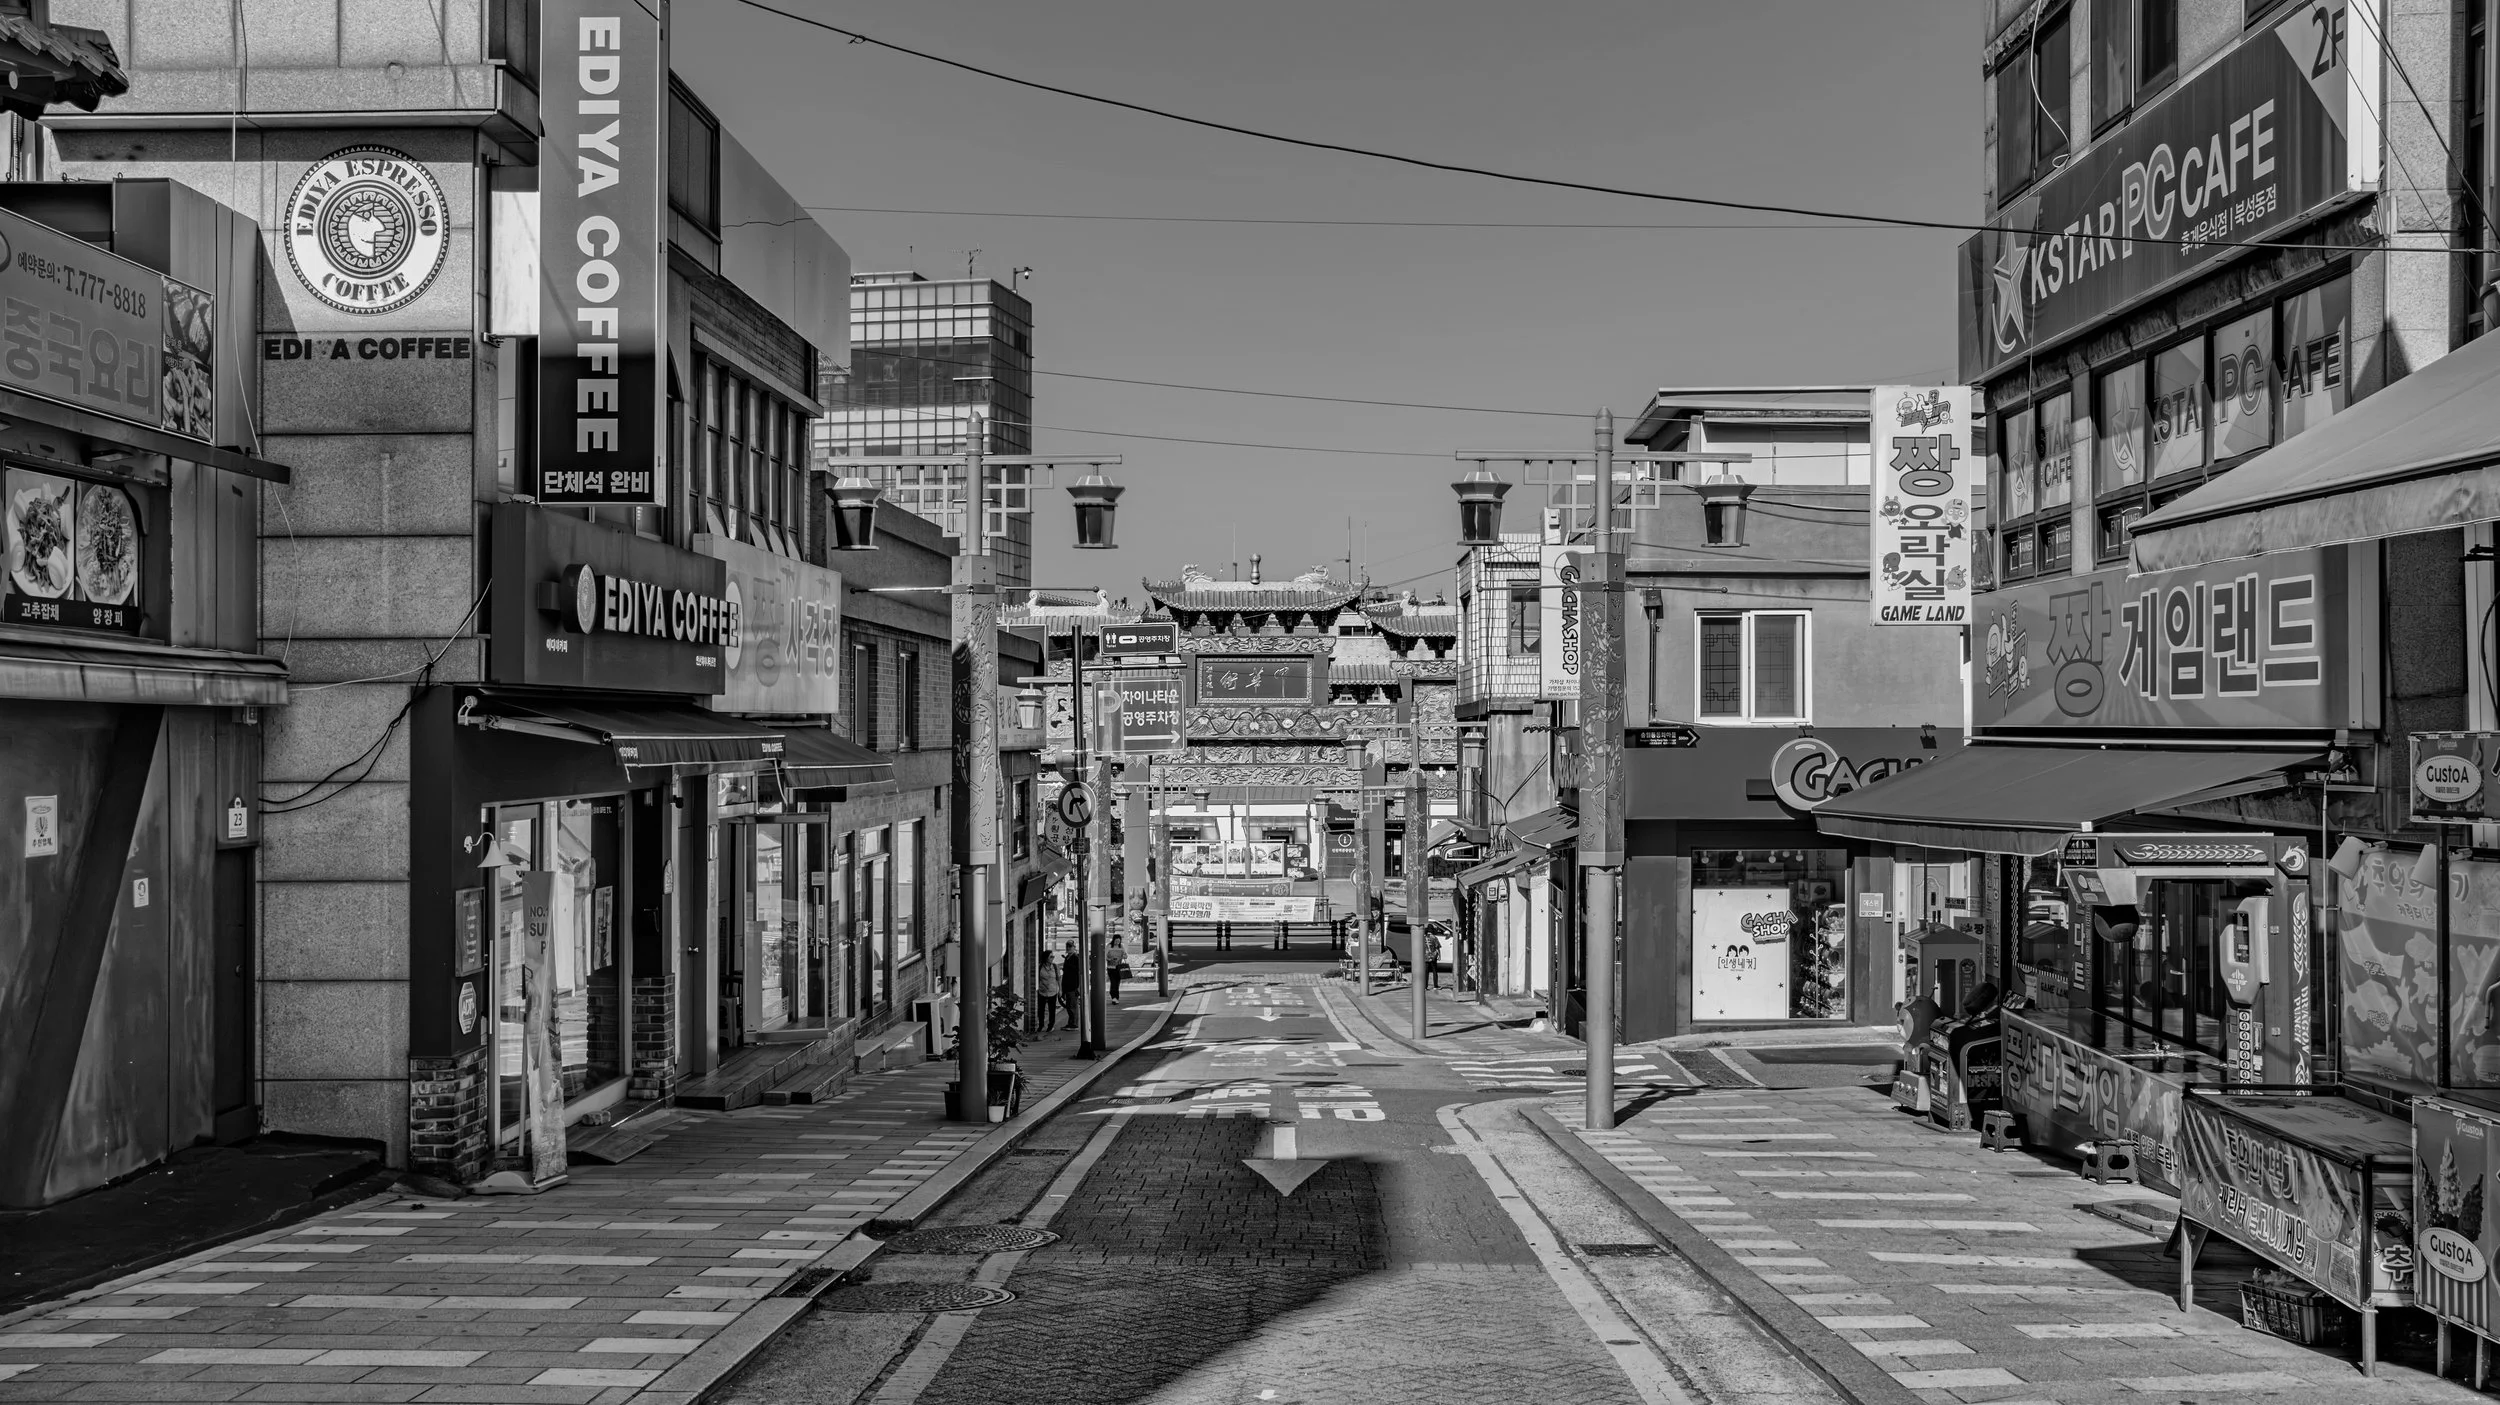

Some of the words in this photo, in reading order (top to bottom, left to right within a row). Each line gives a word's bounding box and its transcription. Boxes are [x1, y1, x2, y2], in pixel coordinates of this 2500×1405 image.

[2311, 6, 2345, 81] 2F
[578, 17, 620, 198] EDIYA
[295, 170, 341, 237] EDIYA
[346, 158, 439, 237] ESPRESSO
[2030, 200, 2116, 305] KSTAR
[2121, 143, 2175, 259] PC
[2180, 98, 2276, 218] CAFE
[2181, 209, 2227, 256] 휴게음식점
[2235, 183, 2276, 226] 북성동점
[322, 271, 411, 301] COFFEE
[4, 296, 157, 416] 중국요리
[358, 337, 470, 360] COFFEE
[576, 215, 620, 453] COFFEE
[2220, 344, 2264, 423] PC
[544, 471, 604, 494] 단체석
[610, 471, 650, 494] 완비
[1889, 433, 1960, 496] 짱
[1898, 504, 1950, 601] 오락실
[604, 575, 667, 638] EDIYA
[672, 589, 739, 648] COFFEE
[1881, 605, 1922, 621] GAME
[1926, 605, 1965, 621] LAND
[785, 596, 838, 680] 사격장
[1138, 635, 1171, 643] 공영주차장
[2046, 581, 2112, 717] 짱
[2119, 572, 2322, 702] 게임랜드
[1098, 690, 1122, 727] P
[1122, 689, 1180, 705] 차이나타운
[1123, 710, 1181, 727] 공영주차장
[2426, 764, 2470, 784] GustoA
[234, 813, 242, 827] 23
[1741, 909, 1798, 928] GACHA
[1752, 922, 1790, 937] SHOP
[2007, 1025, 2120, 1138] 풍선다트게임
[2380, 1244, 2415, 1282] 추
[2430, 1234, 2475, 1268] GustoA
